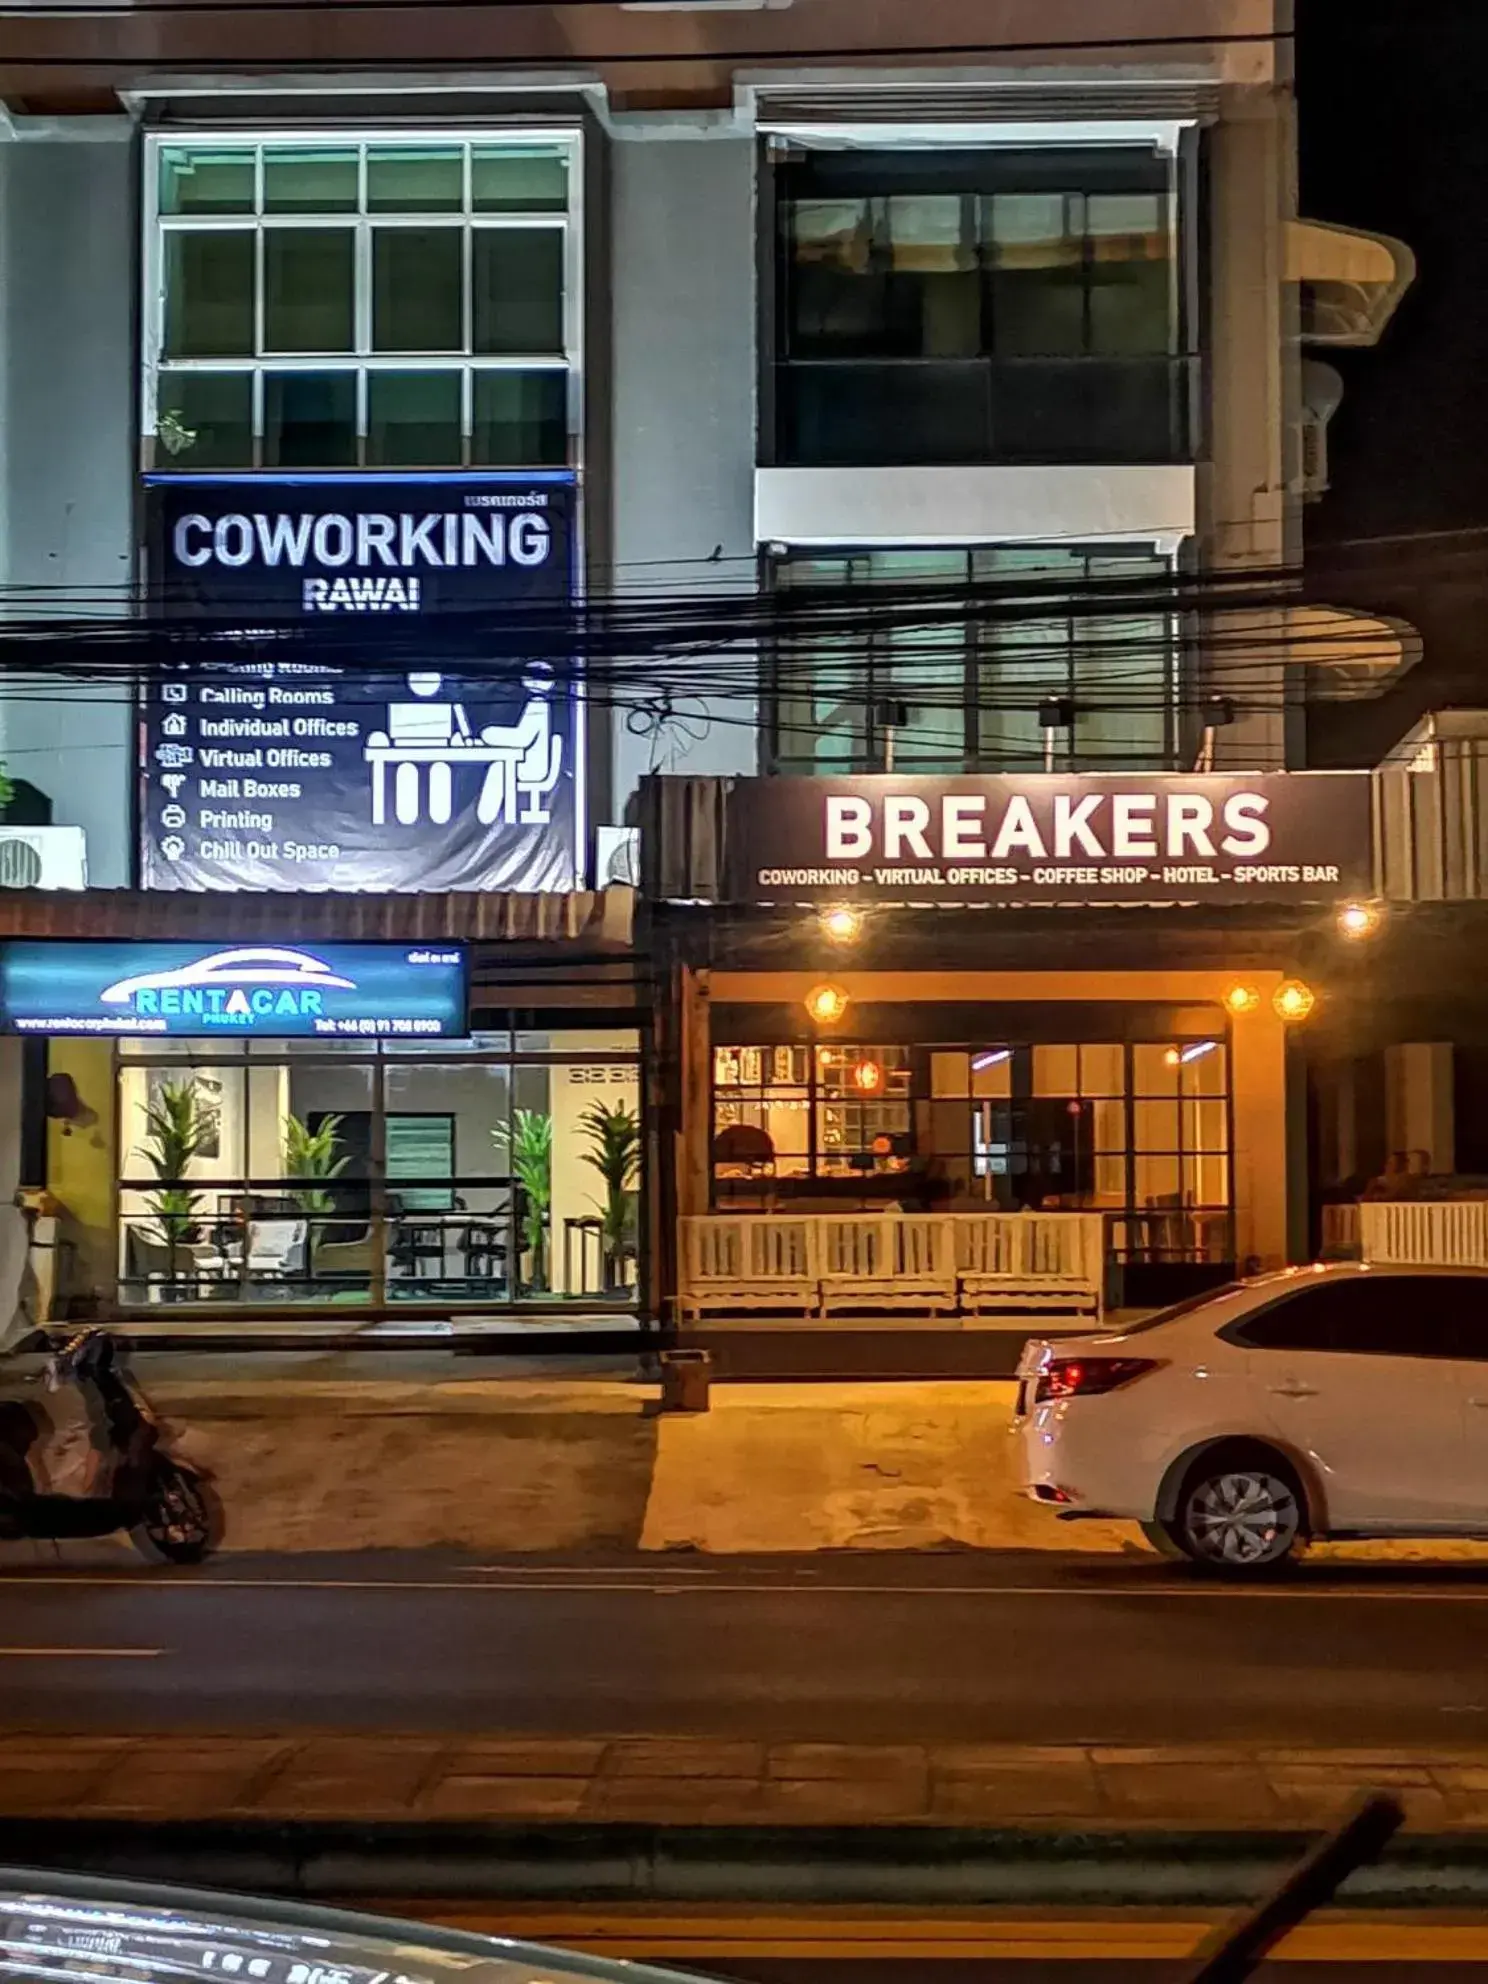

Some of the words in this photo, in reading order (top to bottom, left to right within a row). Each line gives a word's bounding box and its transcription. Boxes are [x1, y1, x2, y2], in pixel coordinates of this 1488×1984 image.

[174, 513, 550, 566] COWORKING
[302, 577, 421, 611] RAWAI
[201, 687, 265, 709] Calling
[268, 687, 335, 704] Rooms
[200, 718, 290, 736] Individual
[293, 718, 360, 736] Offices
[199, 748, 263, 767] Virtual
[266, 748, 332, 767] Offices
[200, 779, 240, 798] Mail
[243, 779, 301, 798] Boxes
[200, 810, 273, 832] Printing
[825, 792, 1270, 859] BREAKERS
[200, 841, 241, 859] Chill
[247, 841, 279, 860] Out
[283, 841, 340, 863] Space
[758, 869, 859, 885] COWORKING
[875, 869, 946, 884] VIRTUAL
[947, 868, 1018, 884] OFFICES
[1033, 868, 1099, 884] COFFEE
[1100, 867, 1149, 883] SHOP
[1163, 867, 1219, 883] HOTEL
[1234, 866, 1300, 882] SPORTS
[1302, 866, 1339, 882] BAR
